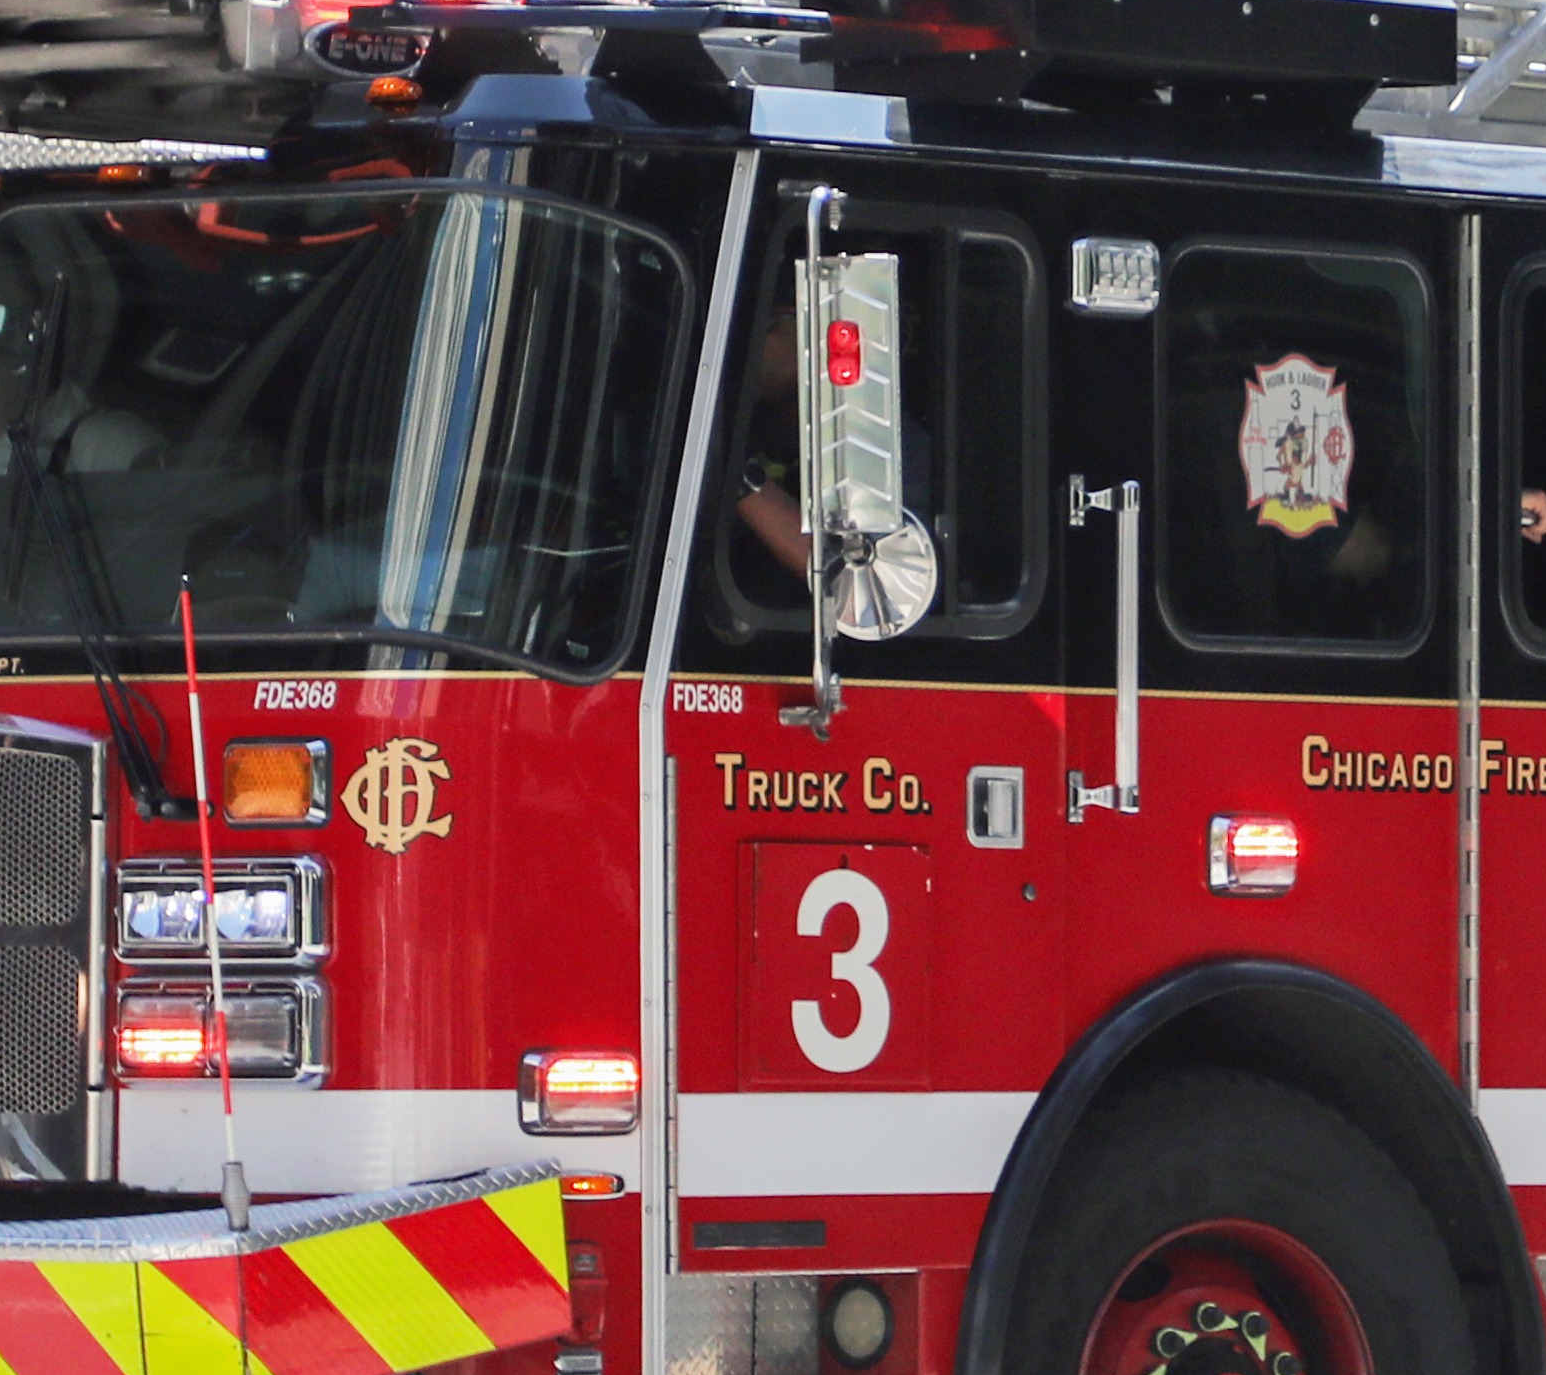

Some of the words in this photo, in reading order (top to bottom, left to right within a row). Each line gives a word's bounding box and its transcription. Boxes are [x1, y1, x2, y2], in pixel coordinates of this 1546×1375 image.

[328, 31, 409, 62] E-ONE
[1291, 389, 1301, 410] 3
[253, 680, 338, 710] FDE368
[673, 682, 743, 714] FDE368
[791, 868, 891, 1074] 3
